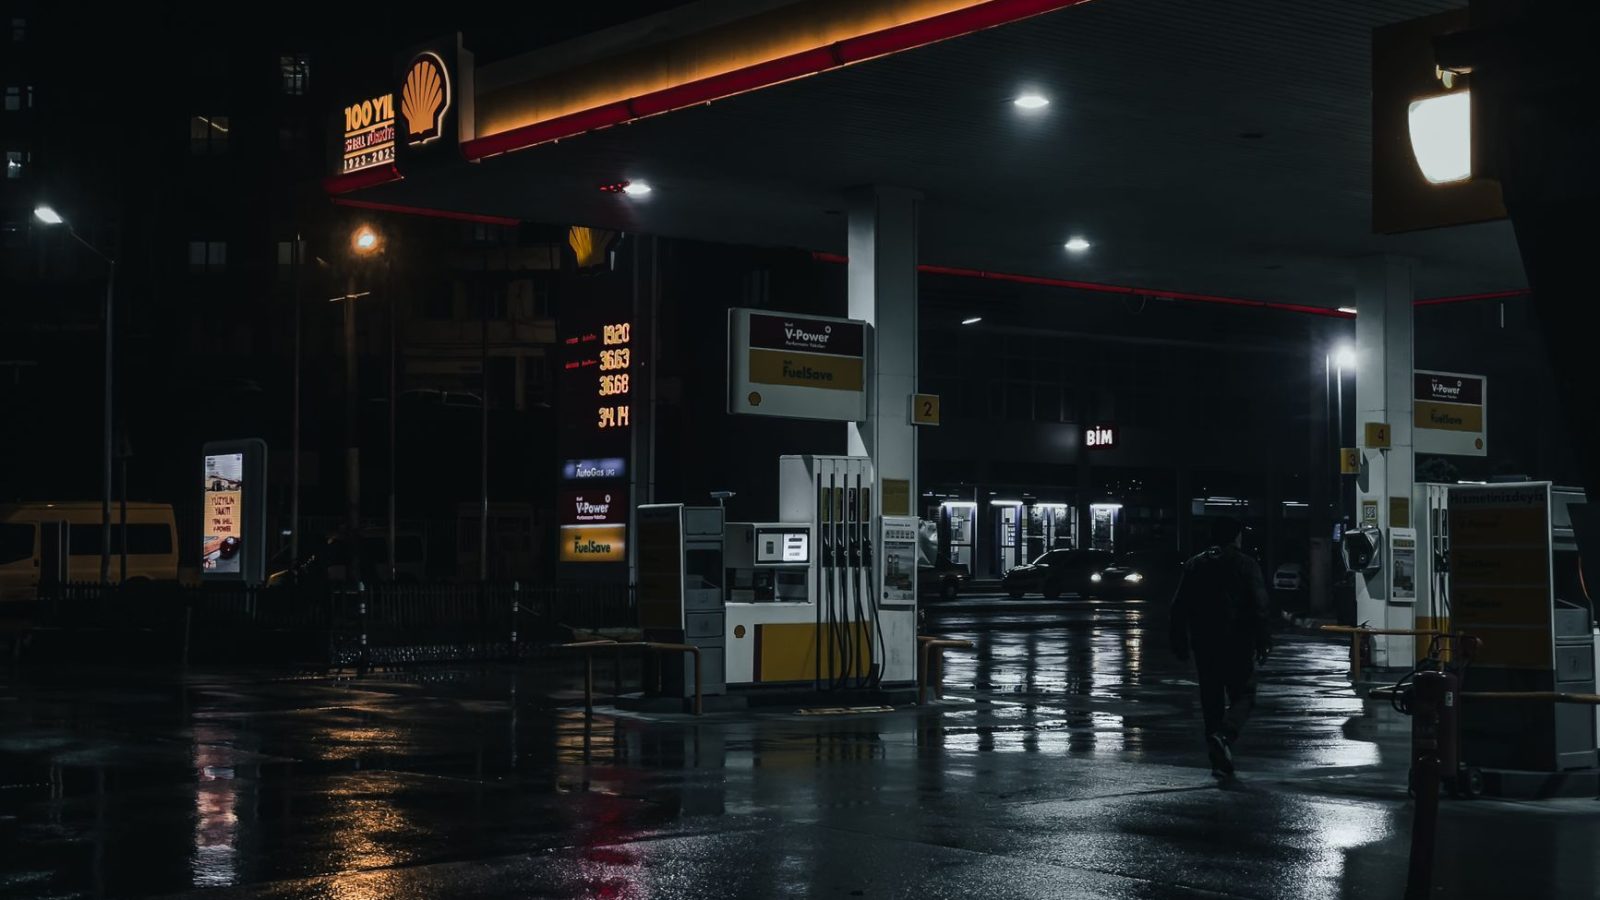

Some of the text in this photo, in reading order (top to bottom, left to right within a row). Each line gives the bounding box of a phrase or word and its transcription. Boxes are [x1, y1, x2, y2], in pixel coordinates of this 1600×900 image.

[345, 94, 395, 131] 100 YIL
[784, 327, 830, 343] V-Power
[783, 366, 833, 381] FuelSave
[1431, 383, 1460, 394] V-Power
[924, 401, 932, 416] 2
[1086, 425, 1113, 446] BİM
[1377, 429, 1385, 442] 4
[1349, 454, 1356, 467] 3
[576, 467, 604, 478] AutoGas
[576, 502, 610, 514] V-Power
[574, 540, 611, 553] FuelSave
